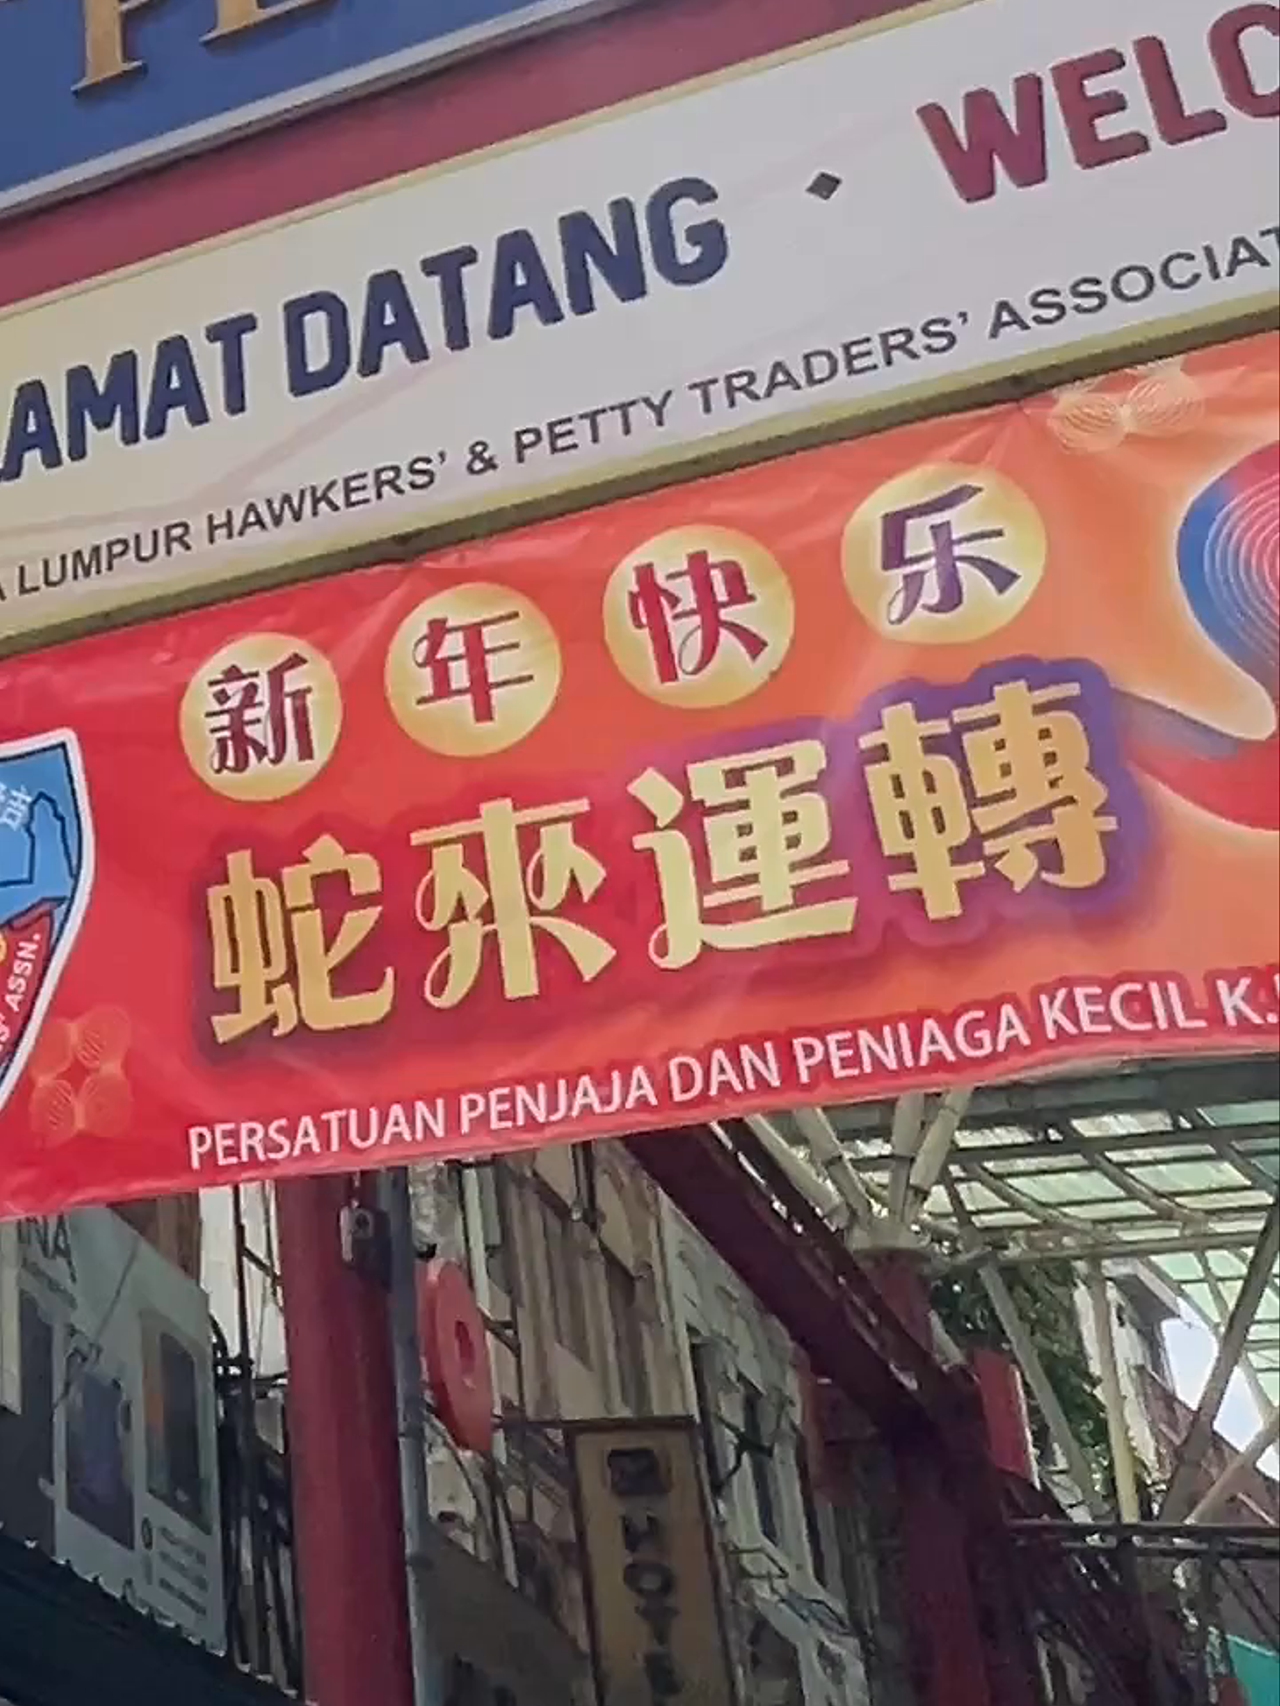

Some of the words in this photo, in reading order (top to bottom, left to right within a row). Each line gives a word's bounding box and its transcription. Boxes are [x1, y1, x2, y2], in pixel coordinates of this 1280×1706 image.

[283, 176, 730, 398] DATANG
[17, 521, 193, 599] LUMPUR
[466, 440, 500, 476] &
[514, 391, 675, 466] PETTY
[204, 484, 1022, 775] 新年快乐
[206, 680, 1119, 1046] 蛇來運轉
[188, 1097, 445, 1171] PERSATUAN
[458, 1063, 659, 1135] PENJAJA
[669, 1040, 782, 1104] DAN
[792, 1002, 1033, 1084] PENIAGA
[1039, 981, 1208, 1041] KECIL
[1217, 974, 1280, 1028] K.
